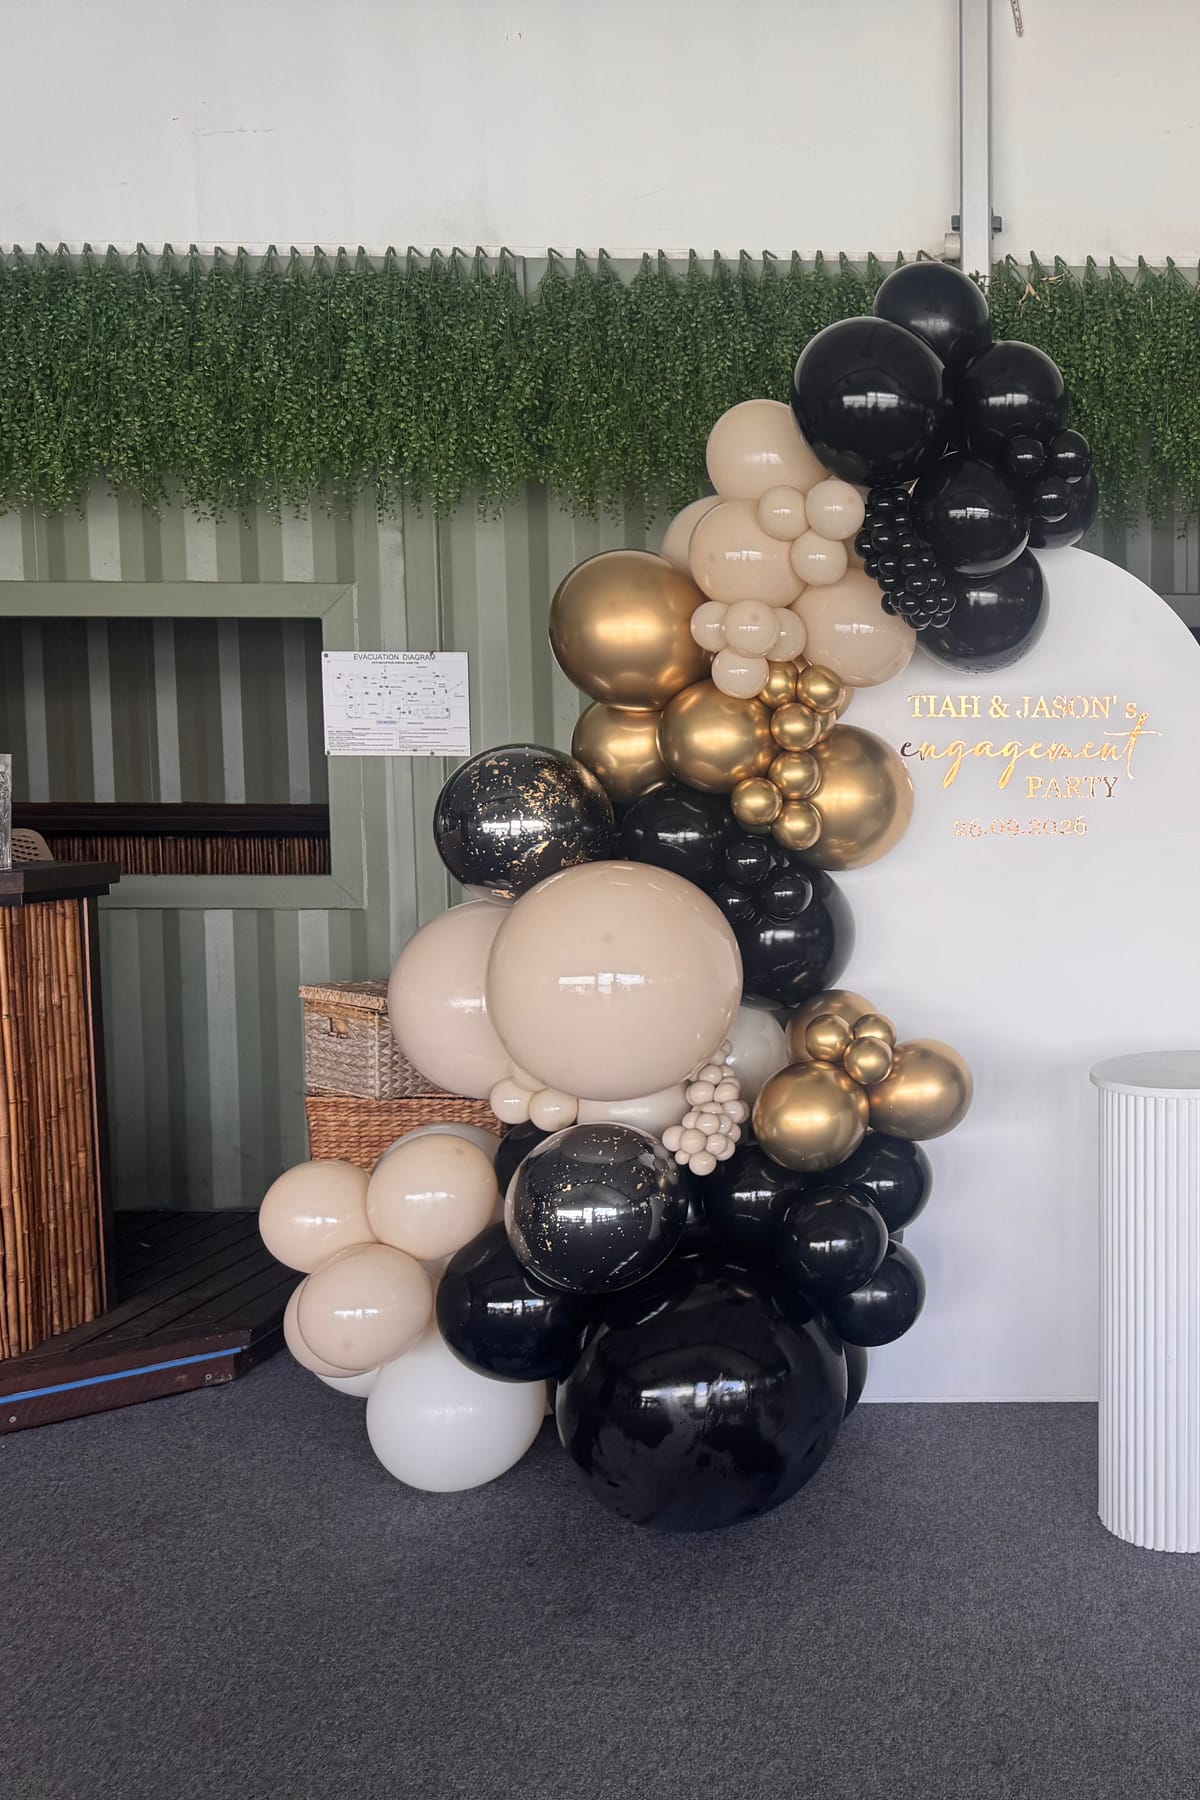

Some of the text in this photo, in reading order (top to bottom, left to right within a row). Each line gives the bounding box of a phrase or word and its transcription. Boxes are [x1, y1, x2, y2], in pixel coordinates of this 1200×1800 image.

[354, 653, 436, 661] EVACUATION DIAGRAM
[907, 695, 981, 718] TIAH
[988, 695, 1010, 718] &
[901, 711, 1163, 789] engagement
[1026, 776, 1119, 798] PARTY
